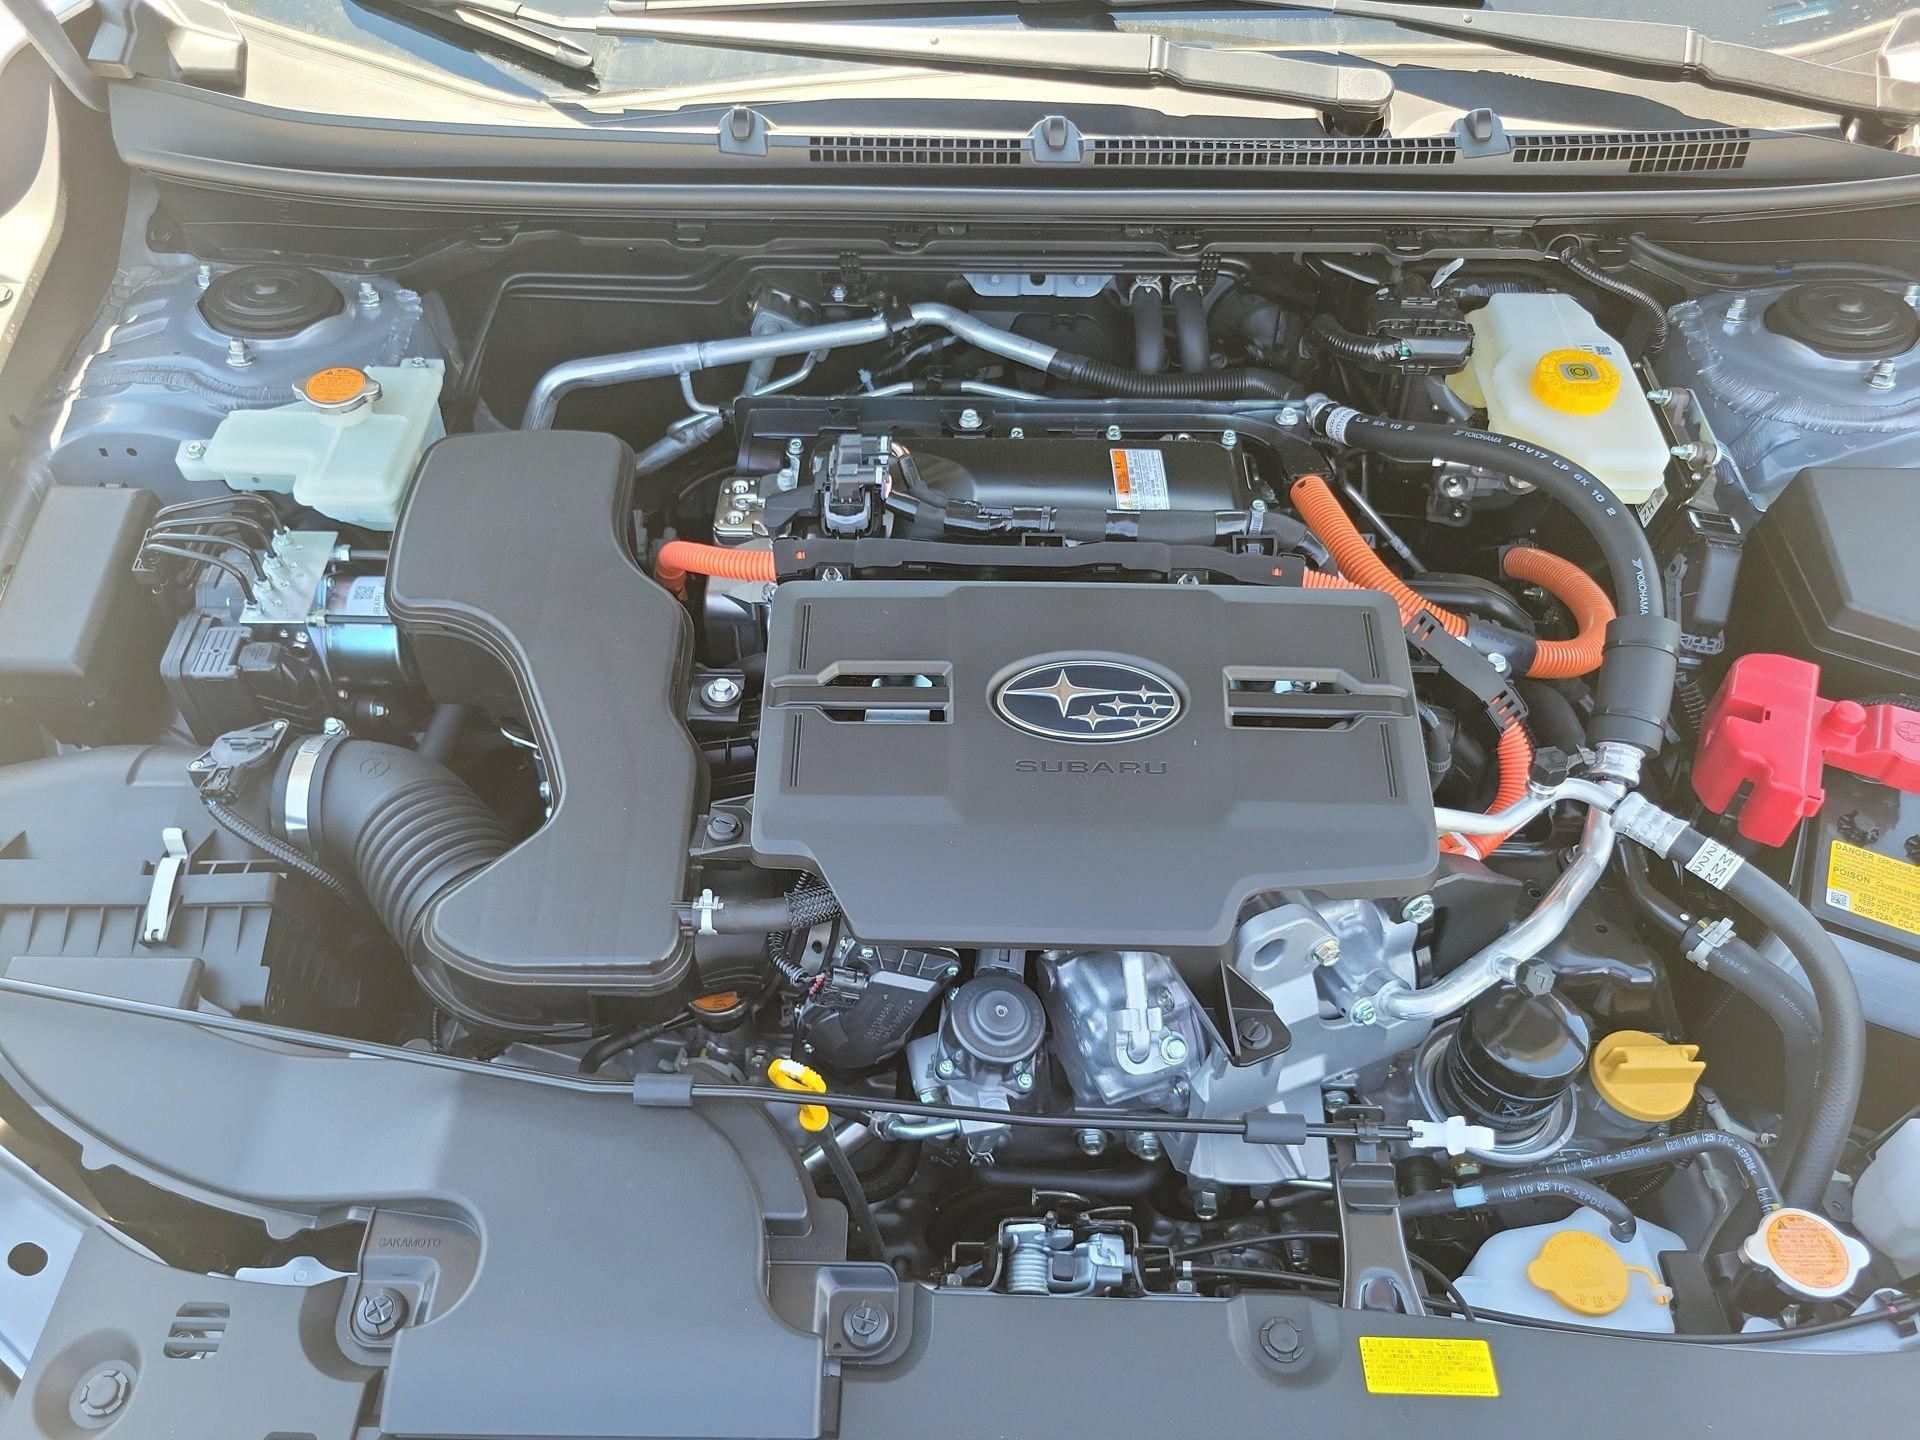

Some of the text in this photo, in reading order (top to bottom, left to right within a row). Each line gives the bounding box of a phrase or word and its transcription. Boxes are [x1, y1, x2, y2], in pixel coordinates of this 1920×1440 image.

[1508, 441, 1549, 460] ACV17
[1552, 459, 1569, 471] LP
[1606, 507, 1616, 517] 2
[1636, 566, 1649, 616] YOKOHAMA
[1015, 758, 1168, 775] SUBARU
[1835, 843, 1875, 860] DANGER
[1833, 866, 1871, 883] POISON
[378, 1237, 441, 1248] SAKAMOTO
